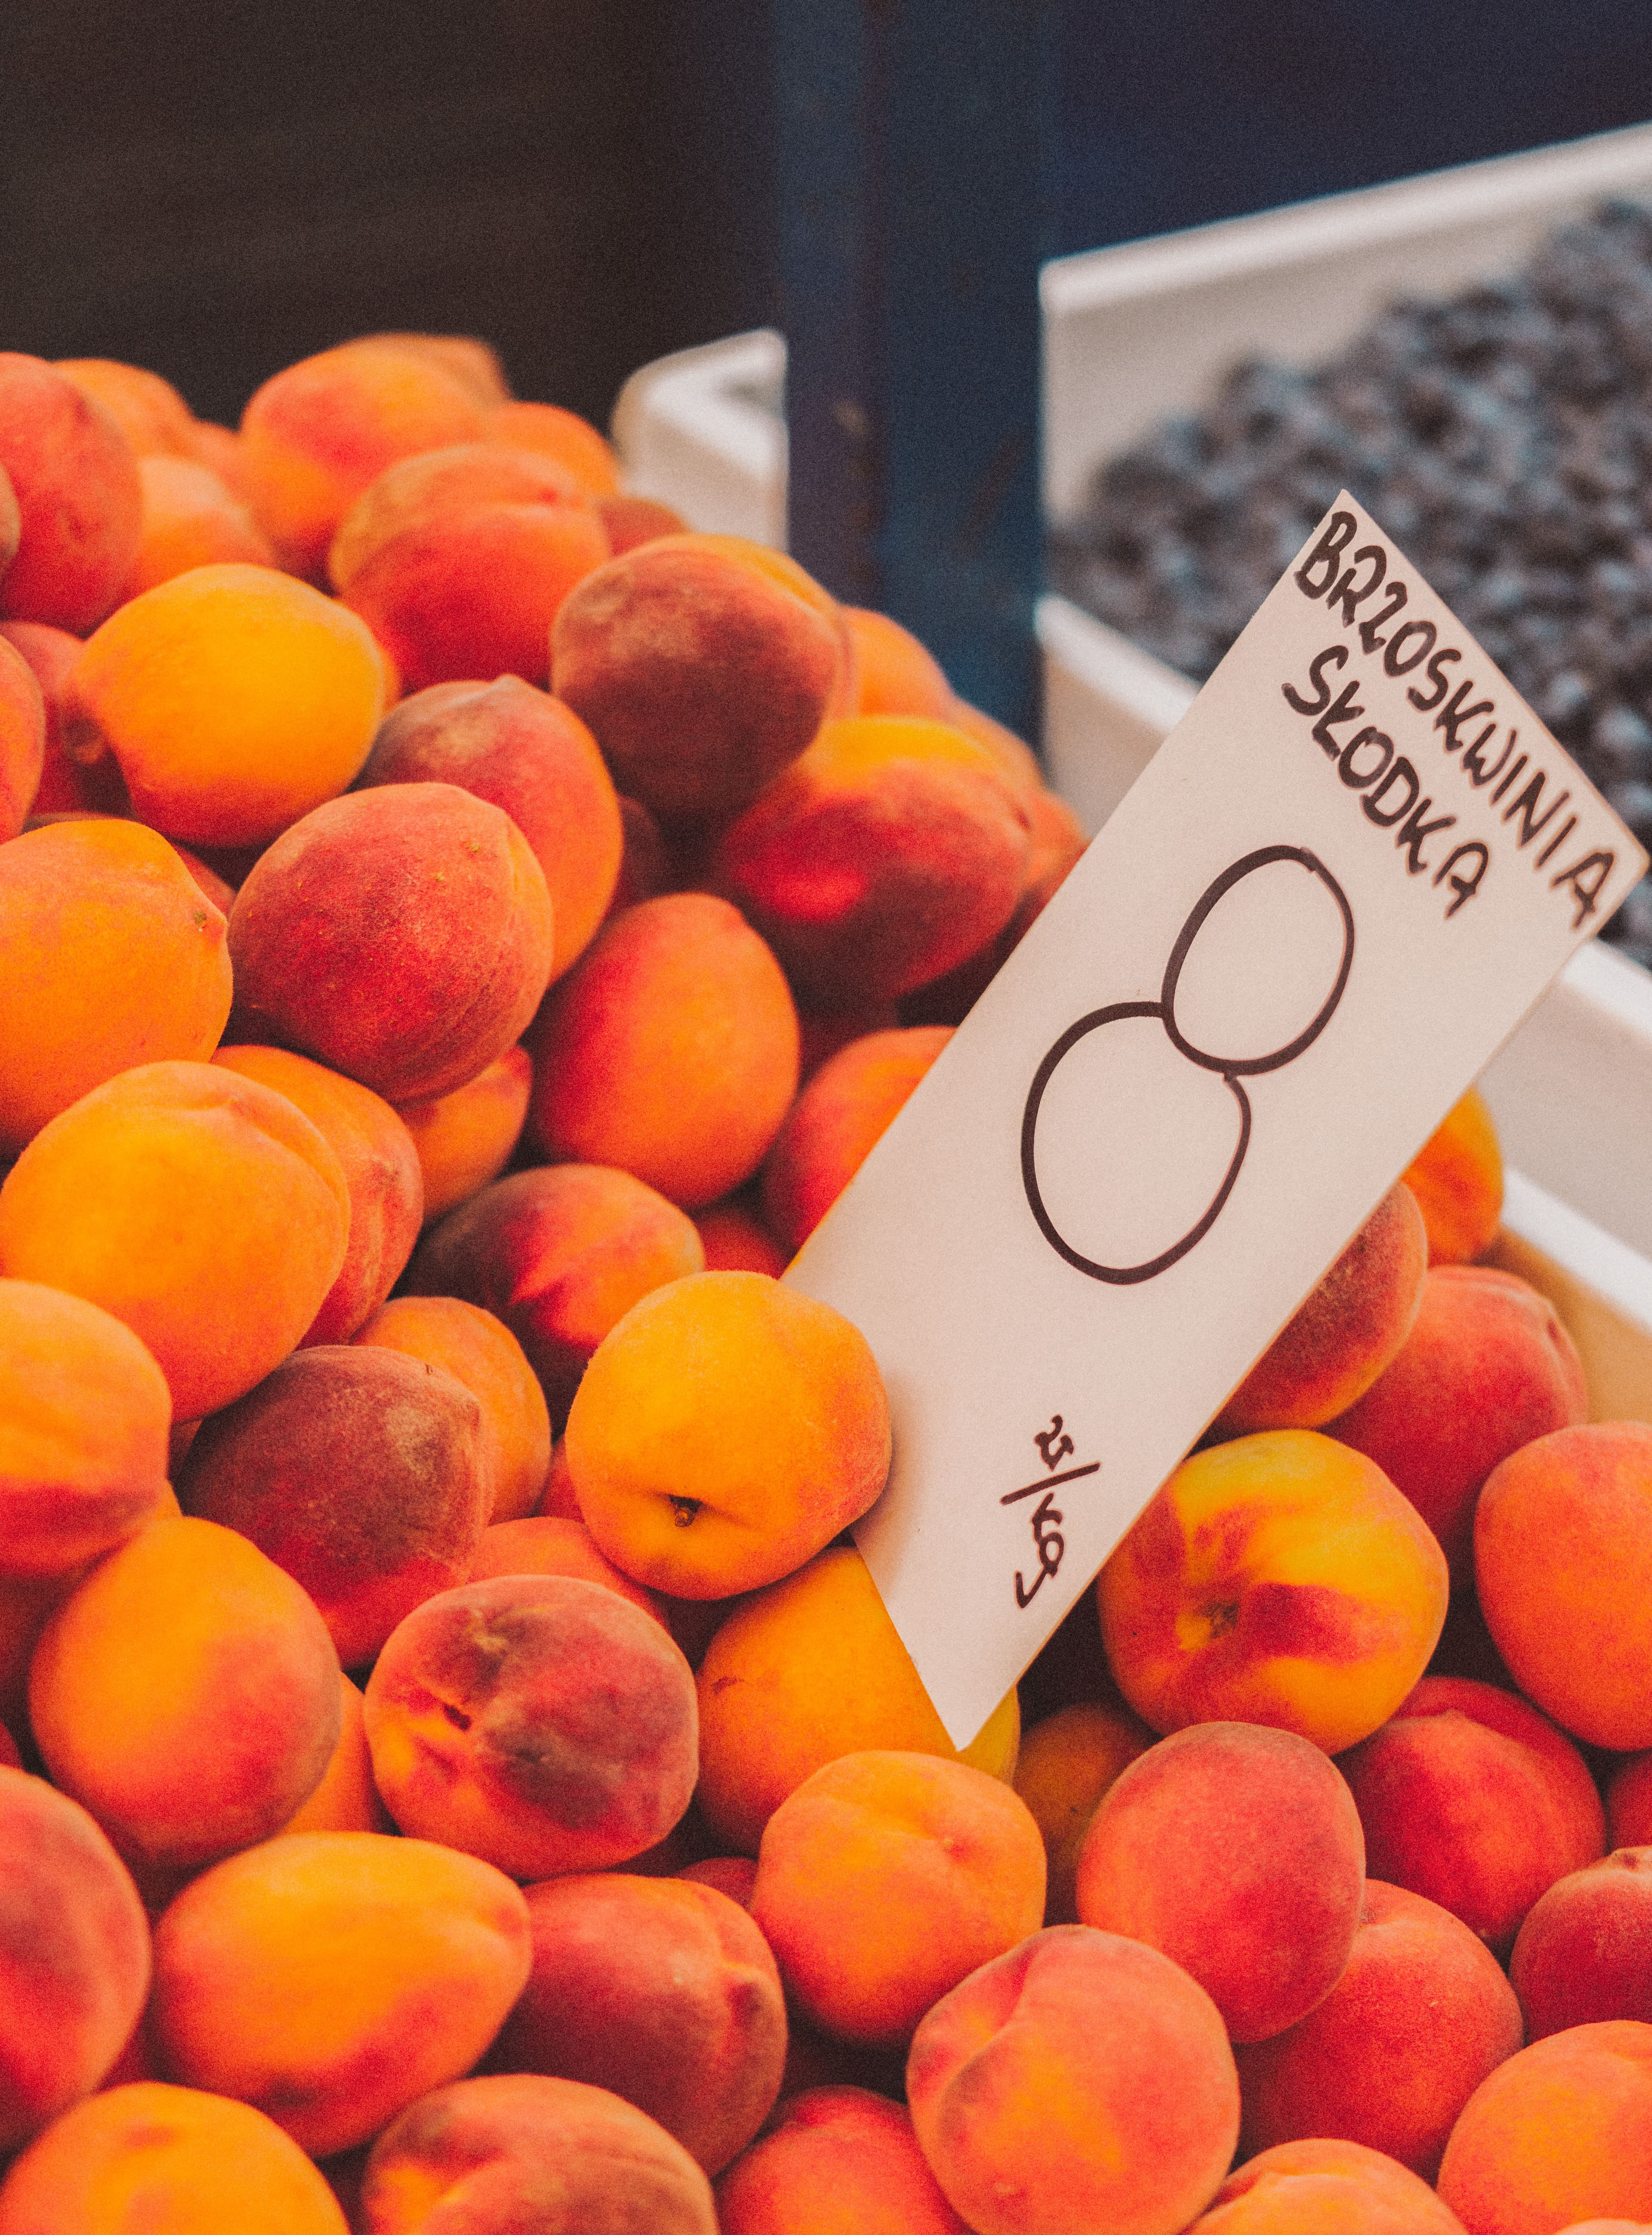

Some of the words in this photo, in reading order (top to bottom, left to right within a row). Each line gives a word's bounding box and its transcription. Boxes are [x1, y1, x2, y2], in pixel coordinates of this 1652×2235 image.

[1281, 645, 1489, 917] SŁODKA
[1295, 511, 1615, 928] BRZOSKWINIA
[1021, 845, 1354, 1285] 8
